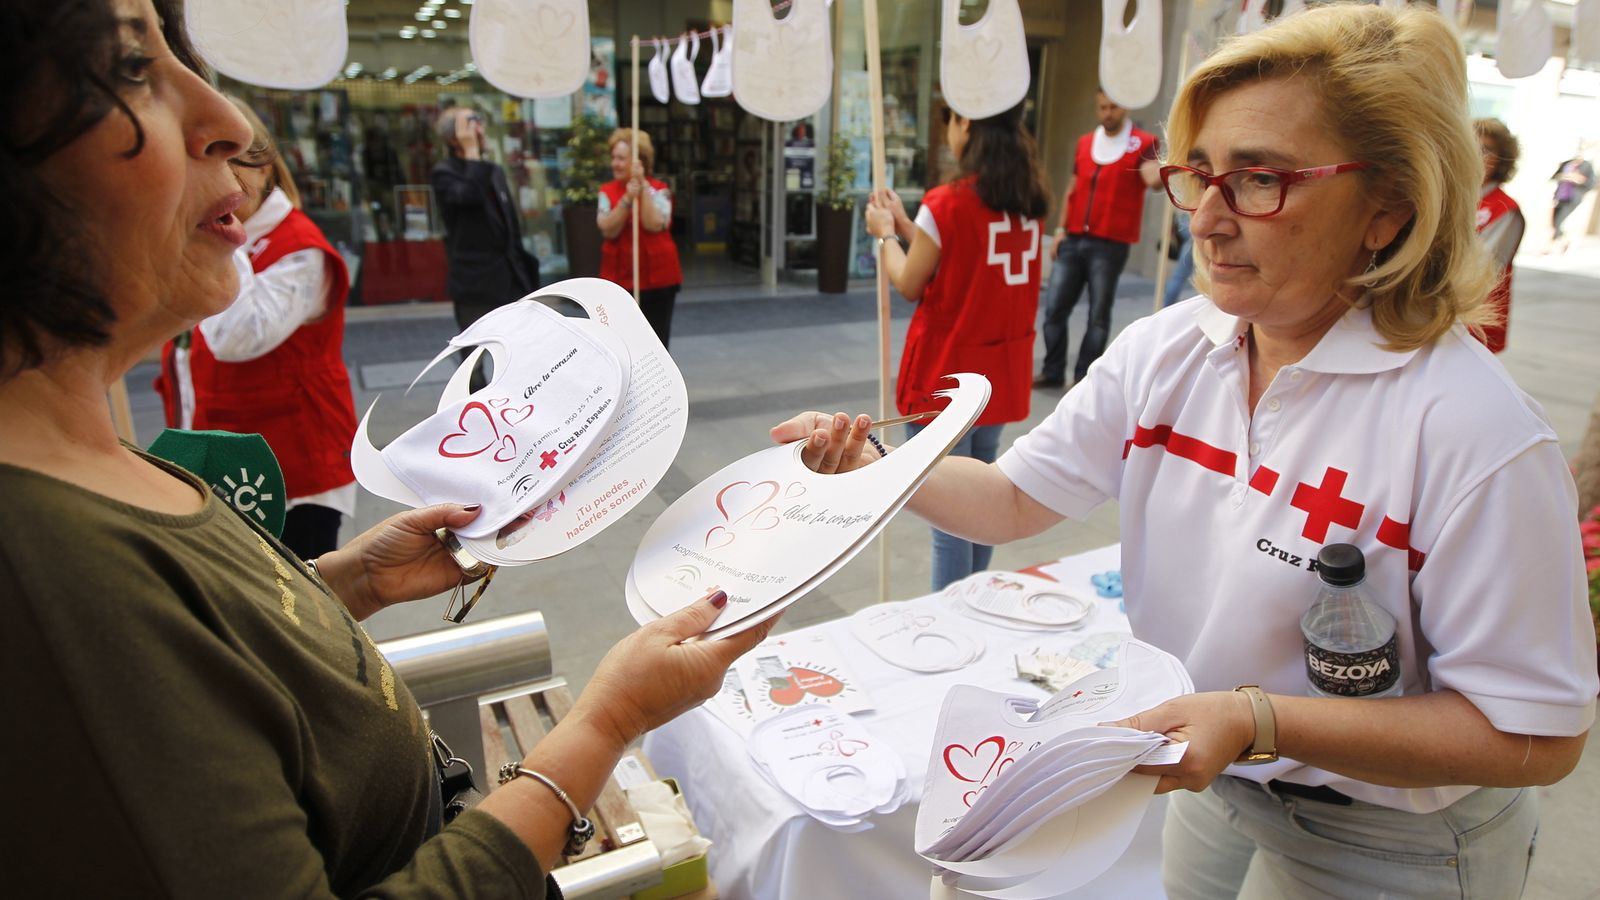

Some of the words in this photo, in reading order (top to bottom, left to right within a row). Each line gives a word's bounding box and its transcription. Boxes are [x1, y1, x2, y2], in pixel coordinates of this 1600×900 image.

[542, 372, 551, 382] tu
[558, 434, 576, 450] Cruz
[574, 423, 589, 438] Roja
[586, 398, 613, 425] Española
[496, 449, 534, 487] Acogimiento
[533, 426, 562, 449] Familiar
[564, 412, 578, 426] 950
[577, 404, 586, 413] 25
[586, 394, 594, 403] 71
[593, 479, 629, 508] puedes
[566, 507, 608, 540] hacerles
[672, 543, 714, 567] Acogimiento
[714, 561, 744, 579] Familiar
[1256, 538, 1303, 568] Cruz
[1307, 653, 1391, 680] BEZOYA
